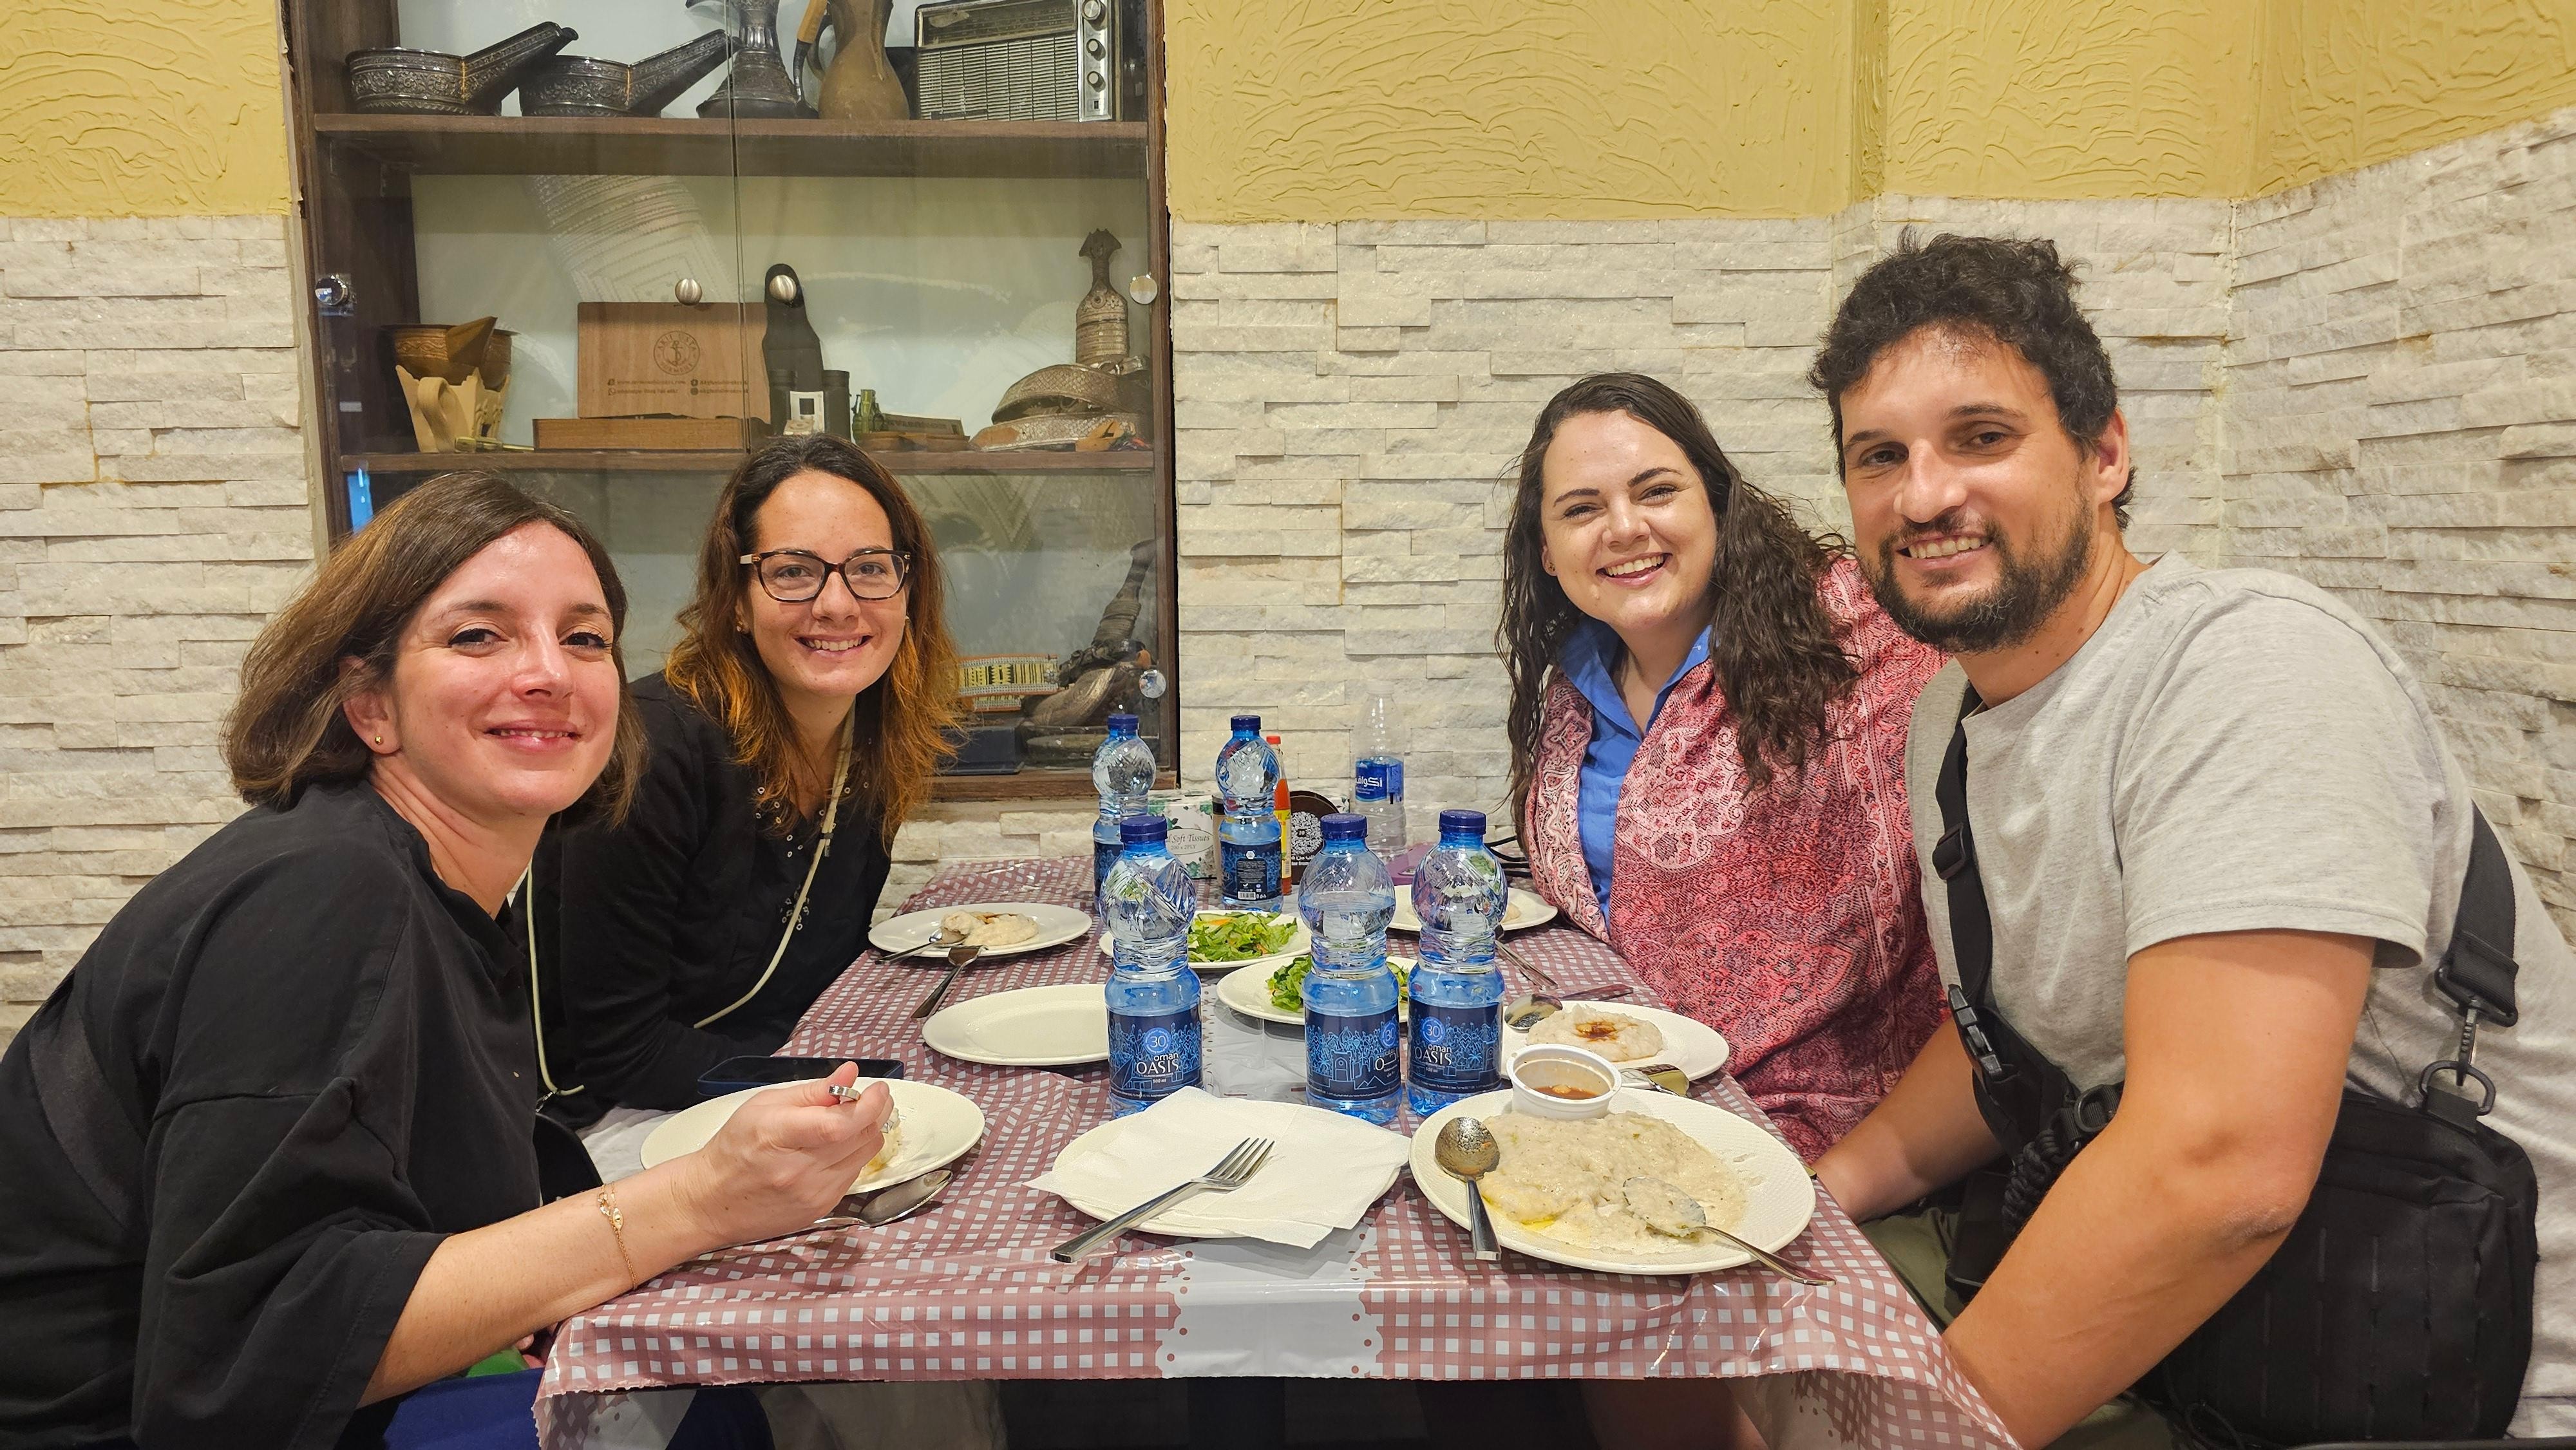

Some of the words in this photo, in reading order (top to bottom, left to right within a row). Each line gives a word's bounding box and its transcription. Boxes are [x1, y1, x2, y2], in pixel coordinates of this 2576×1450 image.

[1171, 834, 1185, 845] Soft
[1188, 834, 1209, 842] Tissues
[1386, 1029, 1395, 1042] 30
[1426, 1024, 1440, 1037] 30
[1151, 1035, 1166, 1048] 30
[1428, 1044, 1452, 1053] oman
[1153, 1053, 1179, 1062] oman
[1415, 1046, 1452, 1066] OASIS
[1136, 1059, 1179, 1075] OASIS
